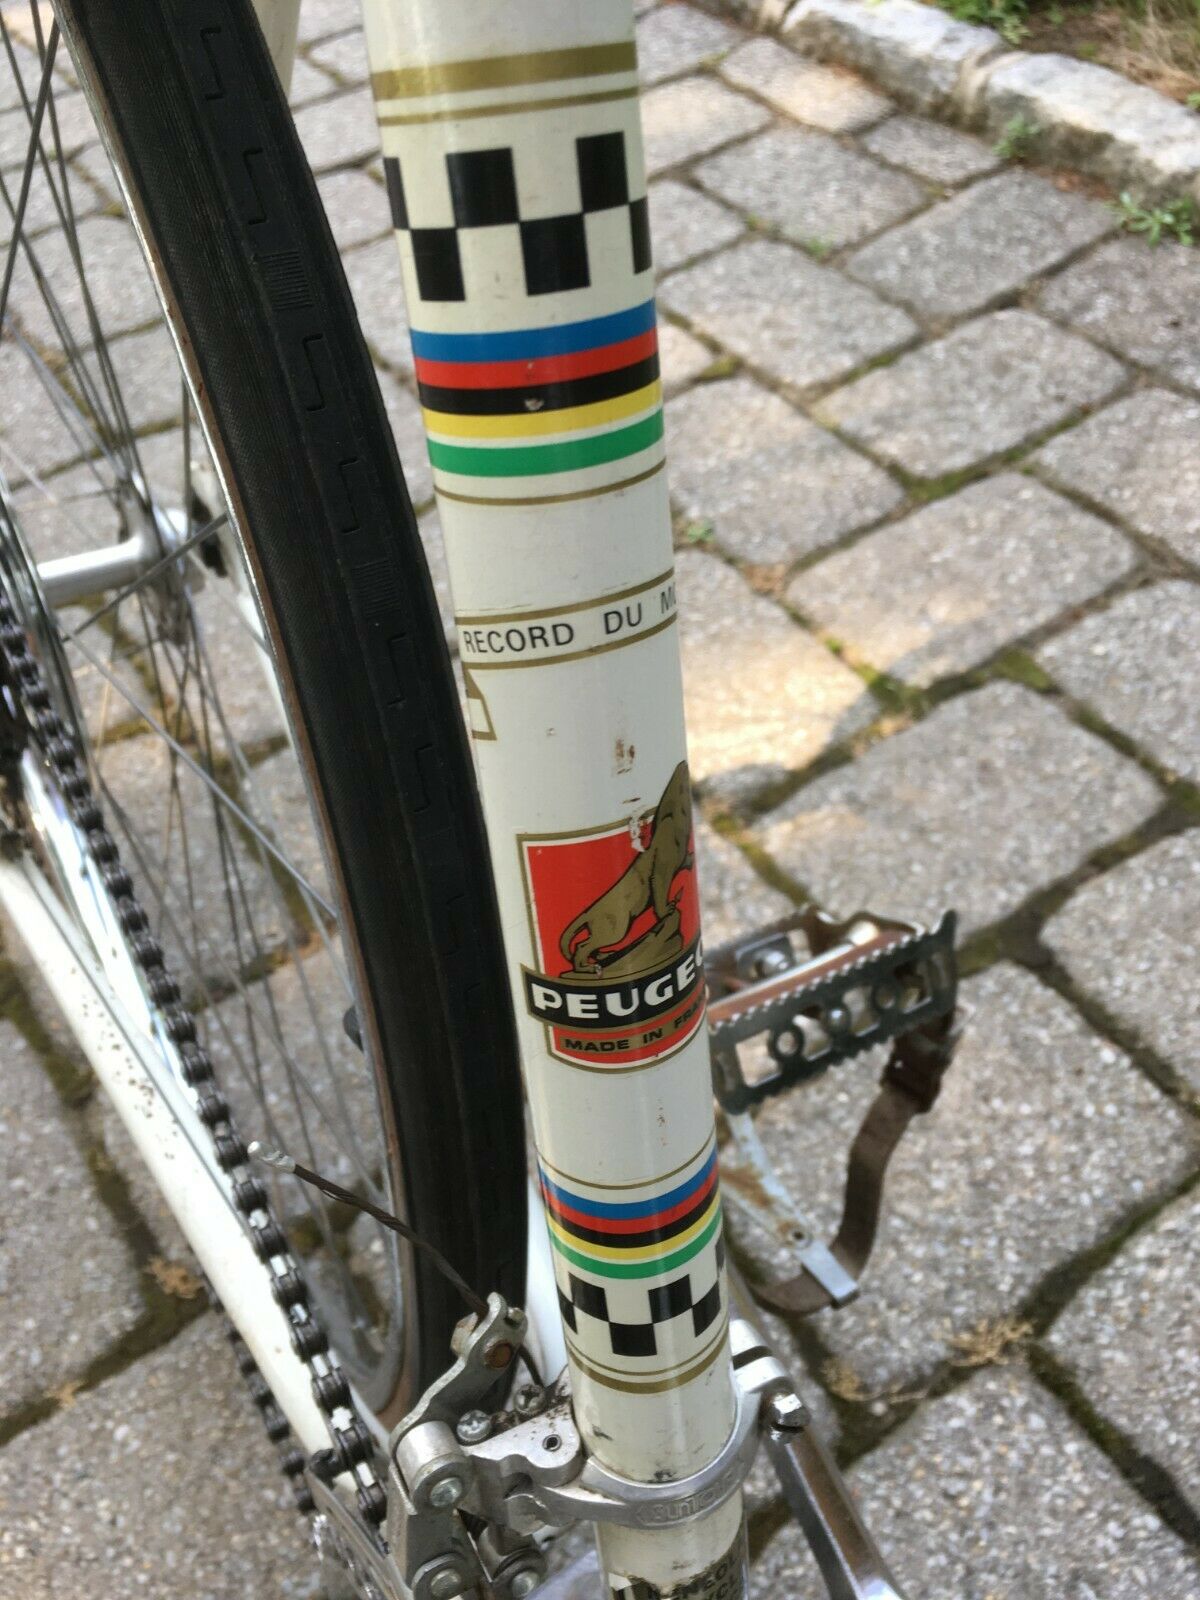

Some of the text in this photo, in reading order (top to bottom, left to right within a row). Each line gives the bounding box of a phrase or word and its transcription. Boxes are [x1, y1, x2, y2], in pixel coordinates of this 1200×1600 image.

[462, 622, 575, 654] RECORD
[603, 602, 643, 635] DU
[564, 1038, 630, 1052] MADE
[643, 1027, 663, 1044] IN
